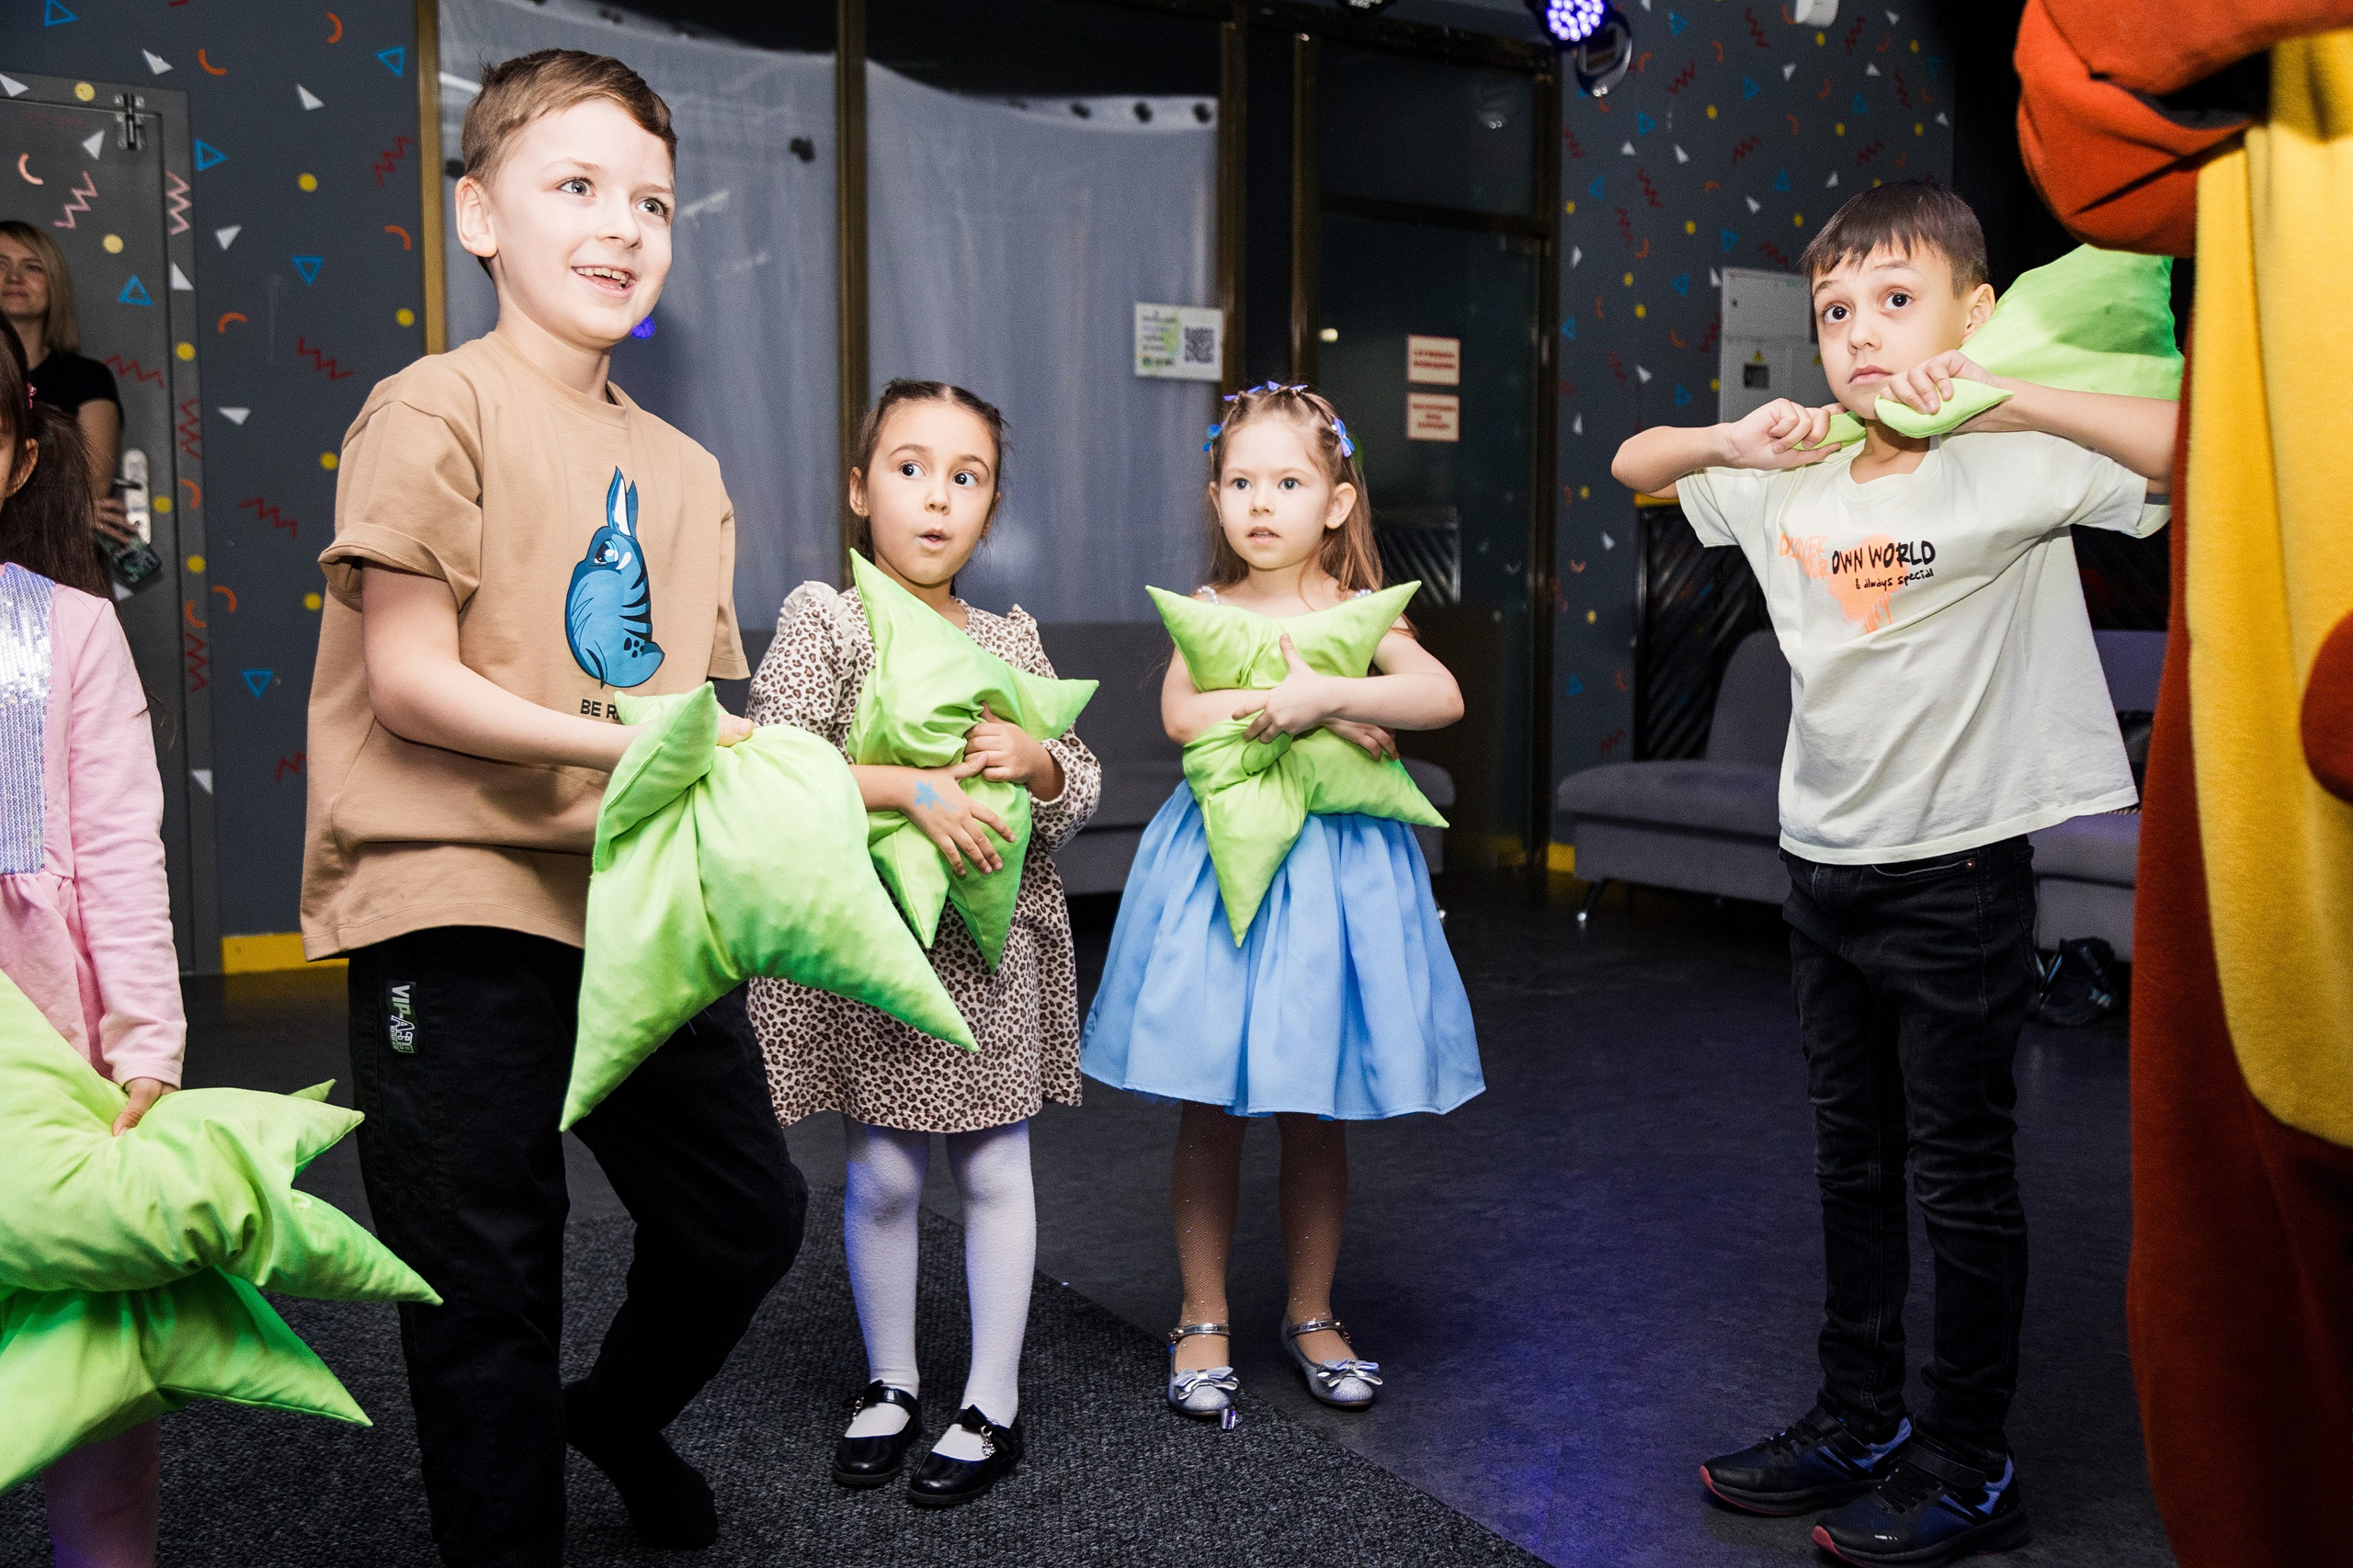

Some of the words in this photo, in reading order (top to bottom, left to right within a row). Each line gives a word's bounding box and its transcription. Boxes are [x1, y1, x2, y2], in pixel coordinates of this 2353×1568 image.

[1832, 550, 1862, 574] OWN
[1868, 540, 1936, 568] WORLD
[1863, 577, 1893, 592] always
[1897, 567, 1934, 586] special
[580, 699, 602, 717] BE
